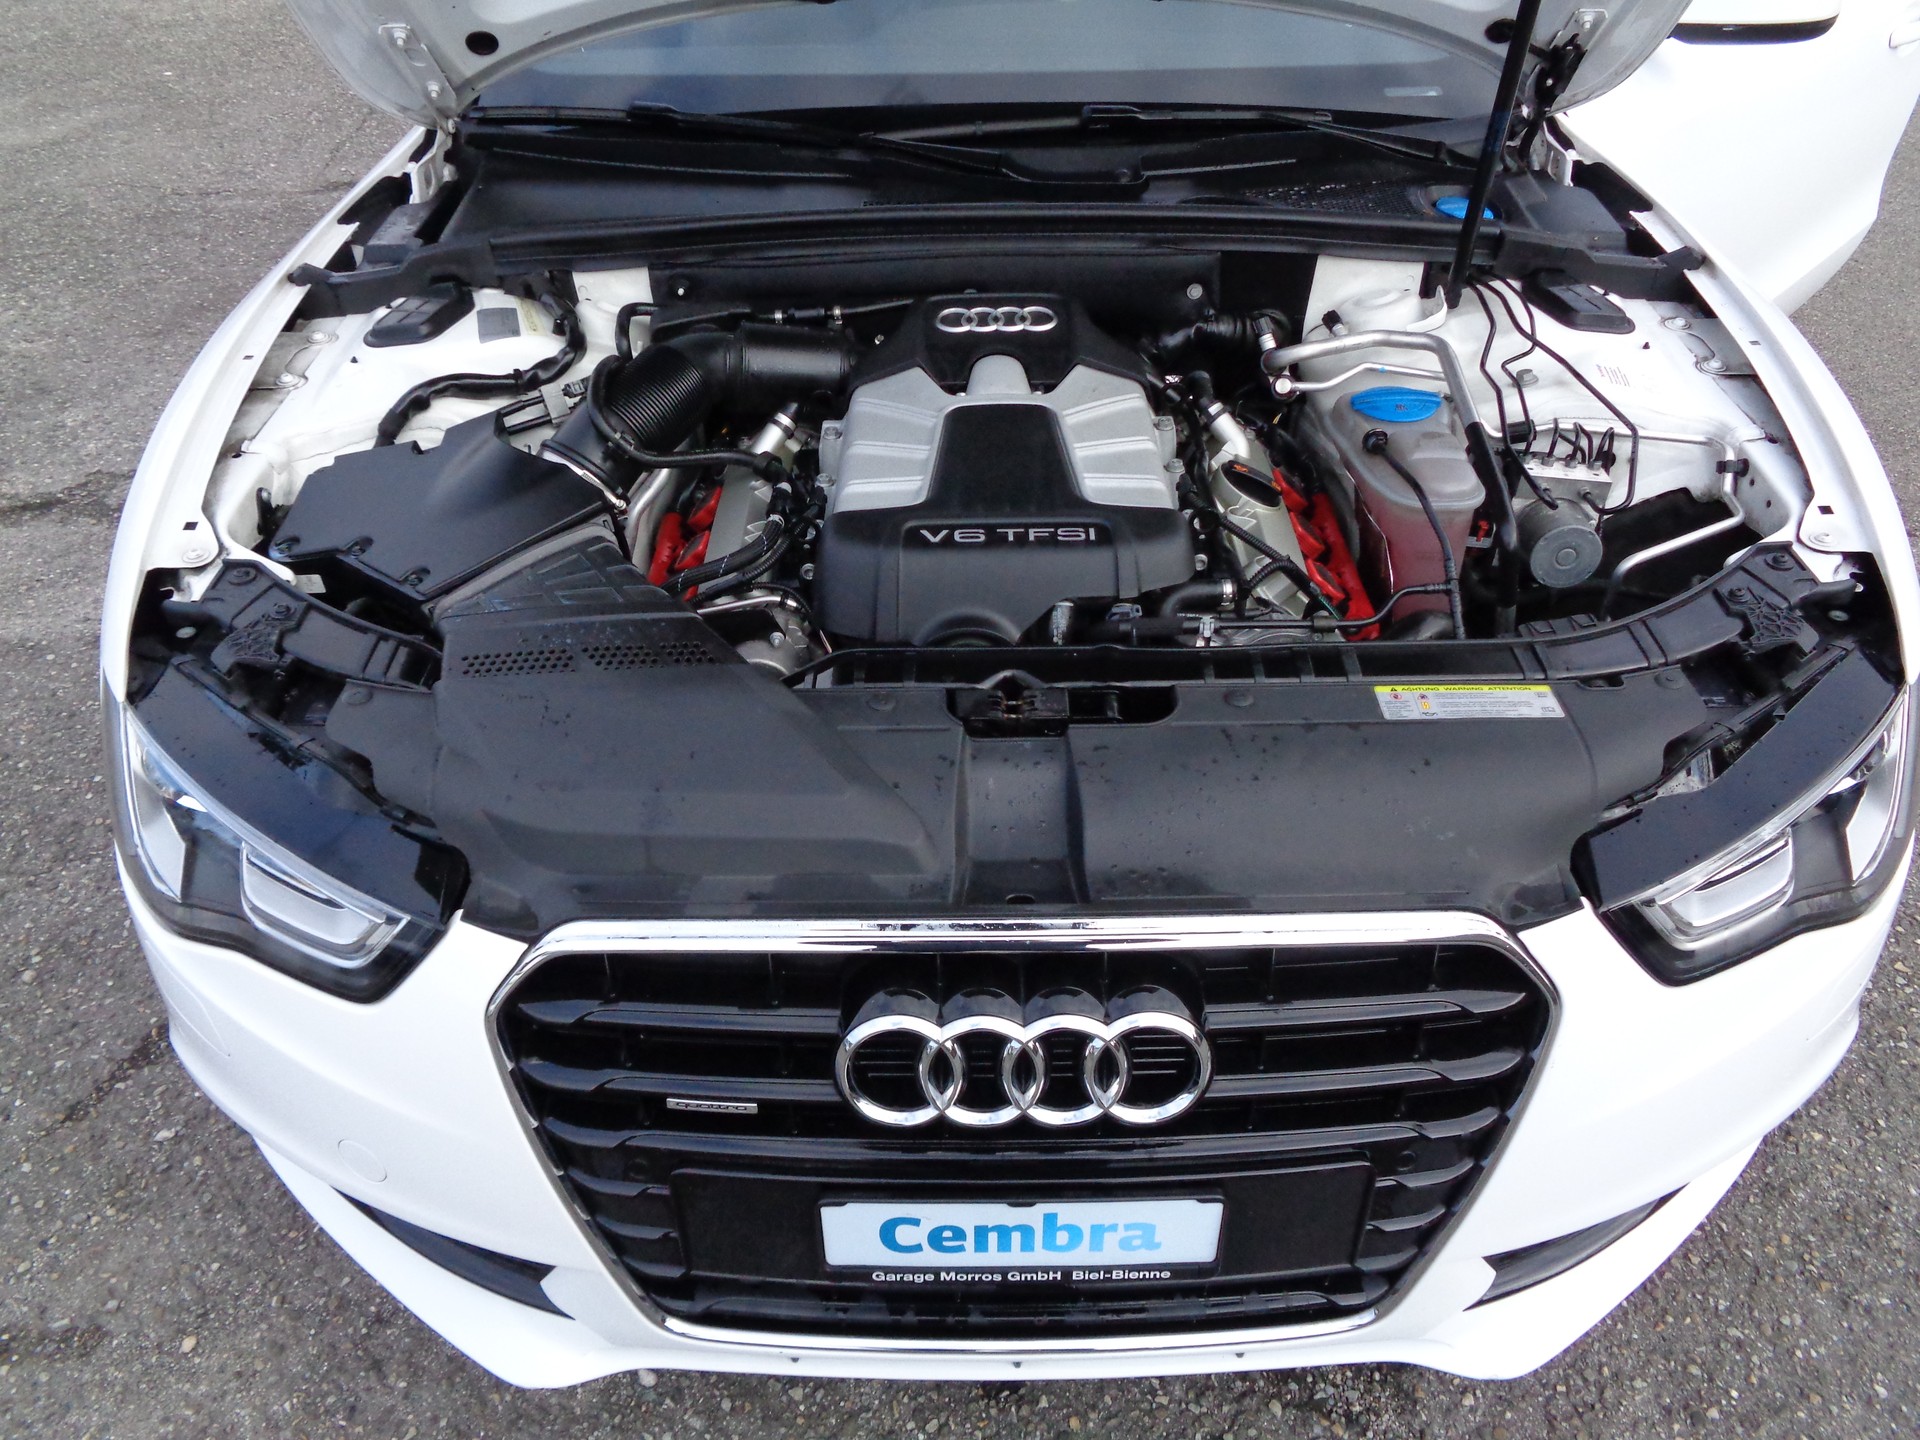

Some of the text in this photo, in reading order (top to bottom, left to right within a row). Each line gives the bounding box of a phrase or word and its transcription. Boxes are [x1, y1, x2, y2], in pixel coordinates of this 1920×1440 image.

[919, 527, 1096, 543] V6 TFSI
[878, 1212, 1163, 1255] Cembra
[871, 1270, 1171, 1284] Garage Morros GmbH Biel-Bienne
